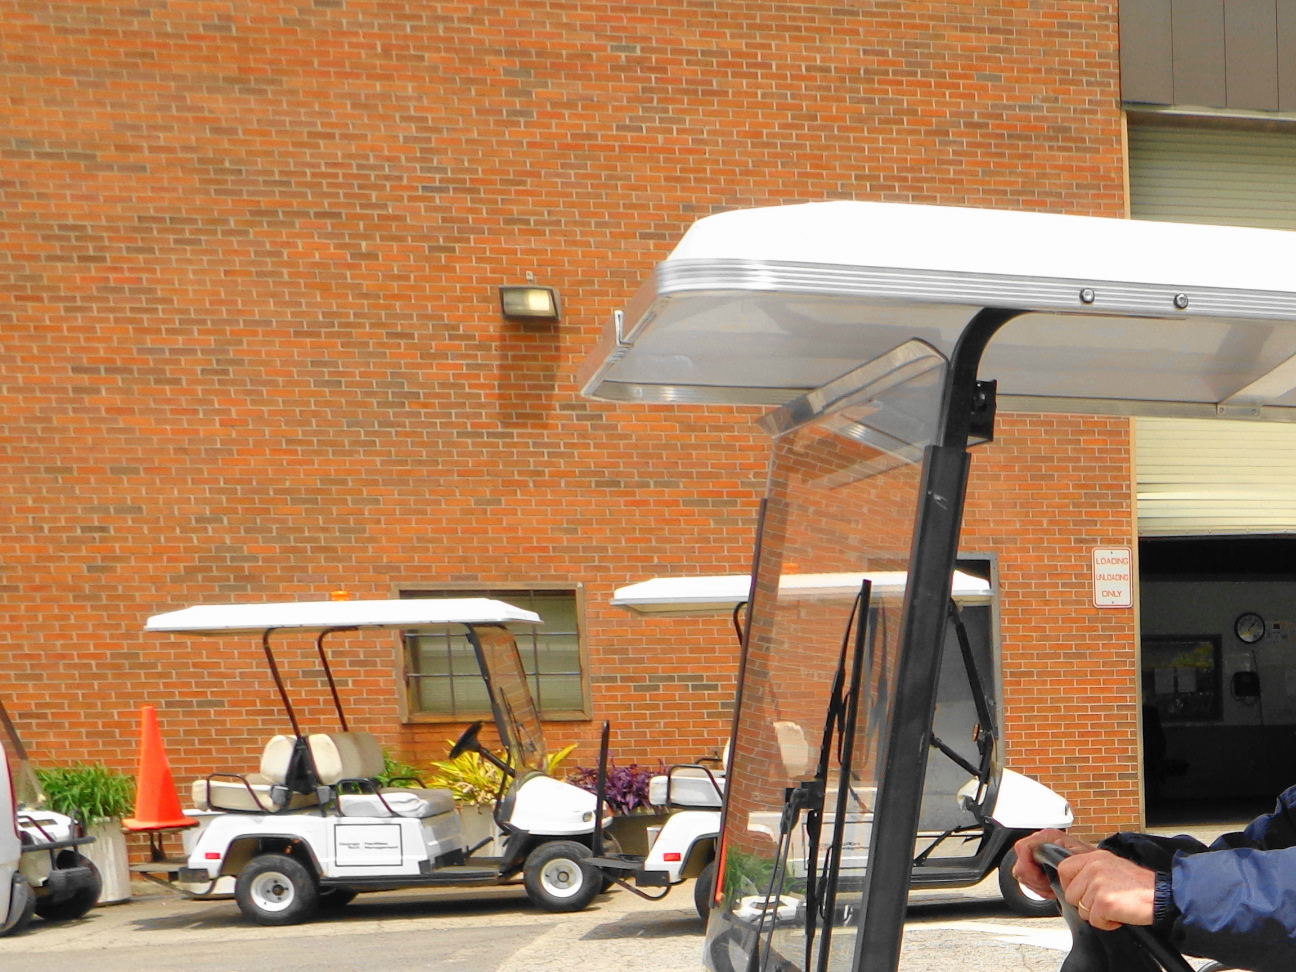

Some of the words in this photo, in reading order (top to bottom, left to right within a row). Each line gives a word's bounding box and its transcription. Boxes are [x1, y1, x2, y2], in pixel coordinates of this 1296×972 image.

[1095, 557, 1129, 565] LOADING
[1095, 573, 1129, 581] UNLOADING
[1101, 590, 1123, 598] ONLY
